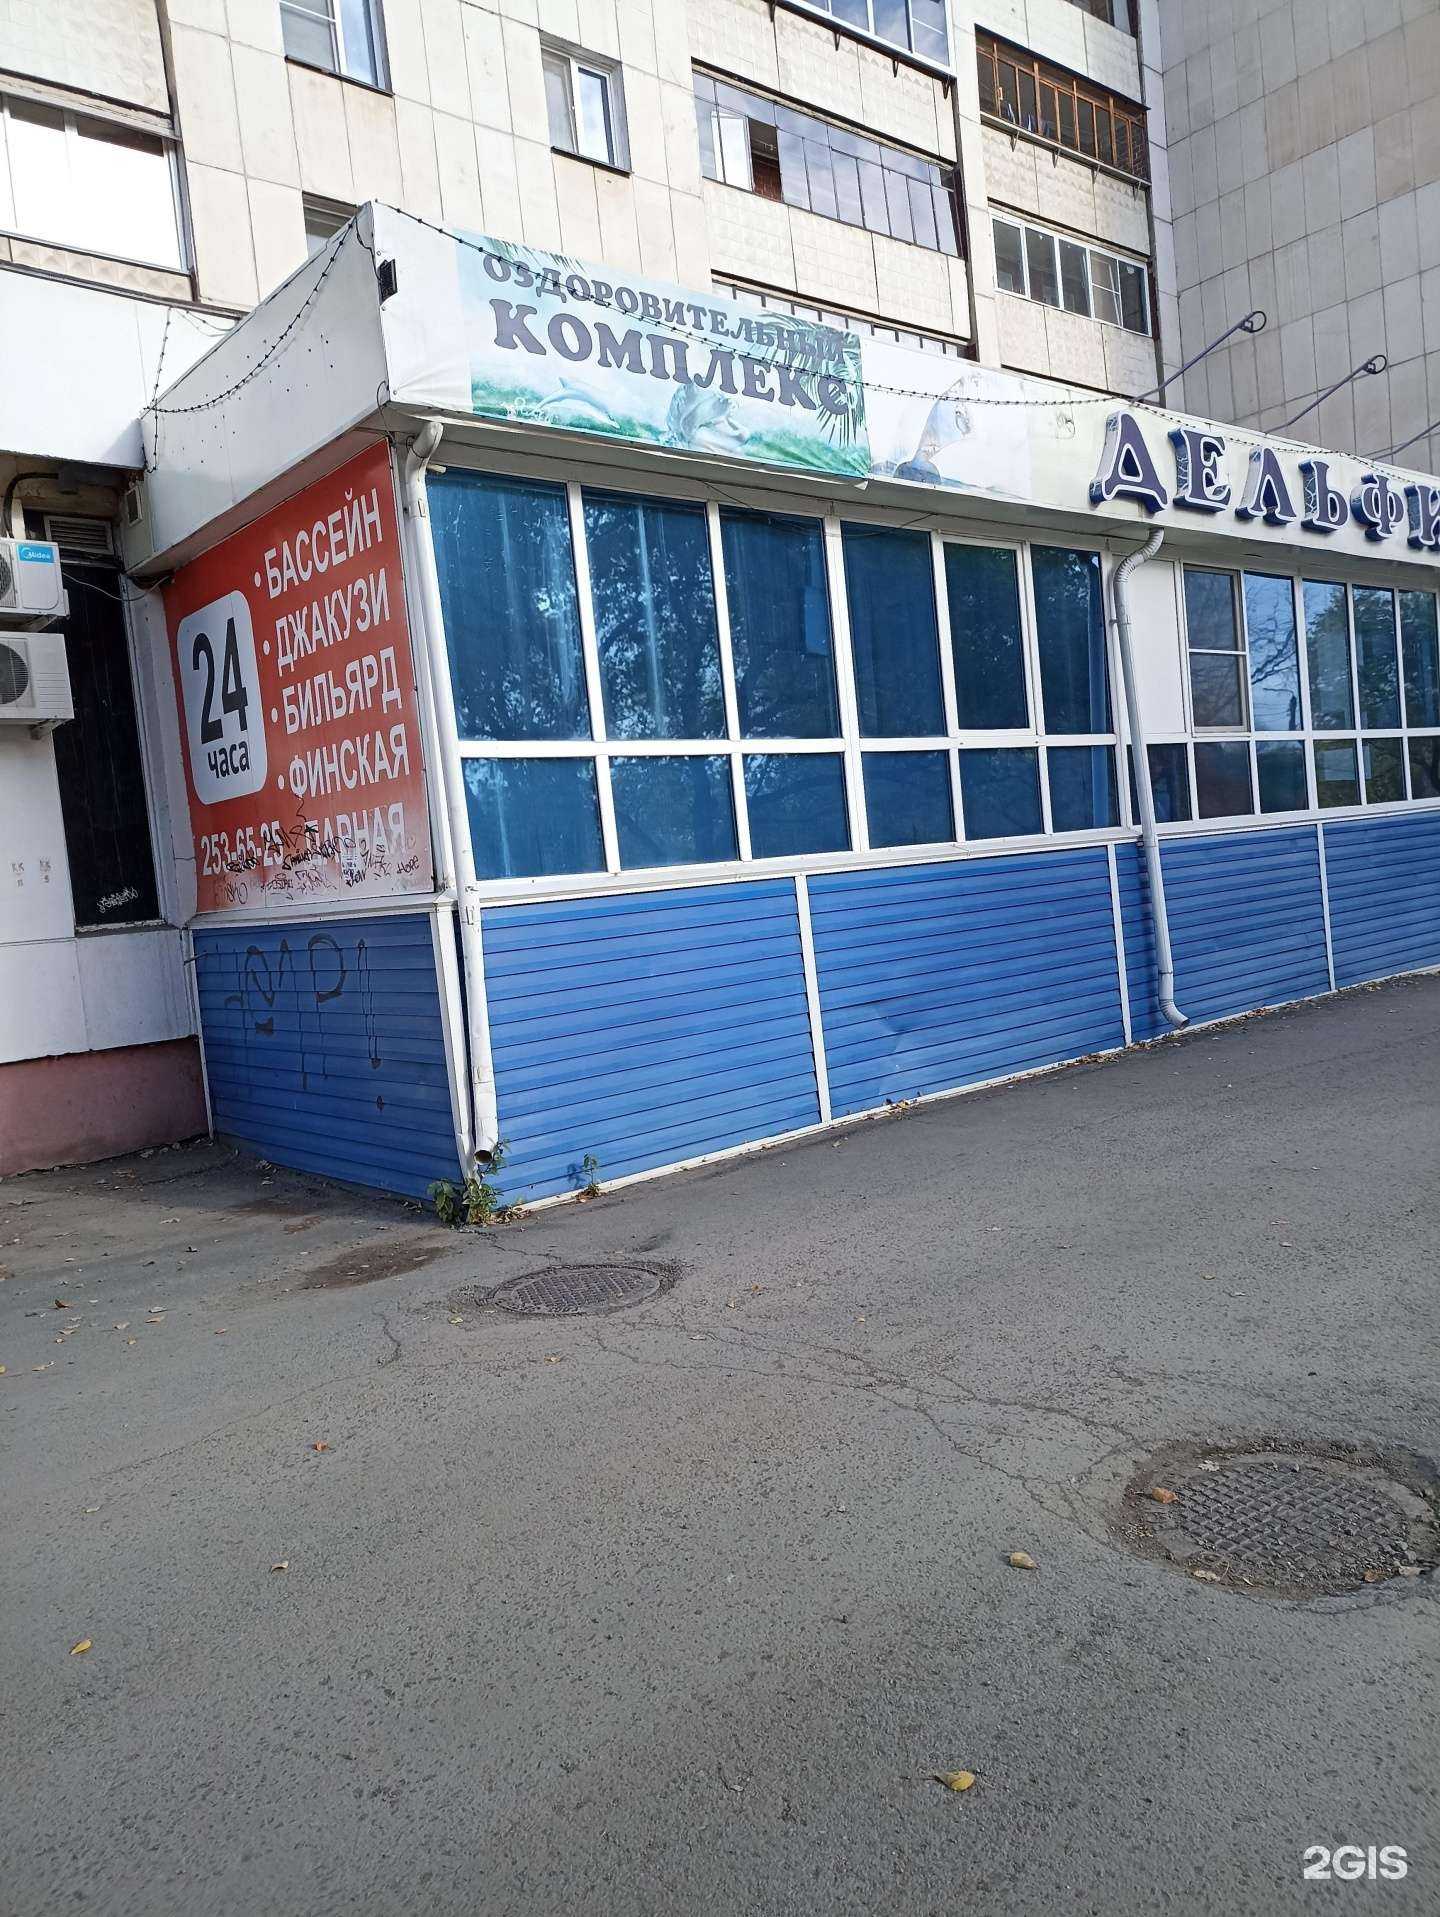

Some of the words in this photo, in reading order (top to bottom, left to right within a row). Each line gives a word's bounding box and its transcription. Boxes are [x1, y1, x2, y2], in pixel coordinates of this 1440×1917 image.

[483, 253, 846, 364] ОЗДОРОВИТЕЛЬНЫЙ
[489, 298, 850, 416] КОМПЛЕКС
[264, 488, 383, 599] БАССЕЙН
[275, 568, 390, 676] ДЖАКУЗИ
[192, 617, 248, 744] 24
[283, 647, 403, 735] БИЛЬЯРД
[208, 741, 250, 779] часа
[289, 723, 410, 799] ФИНСКАЯ
